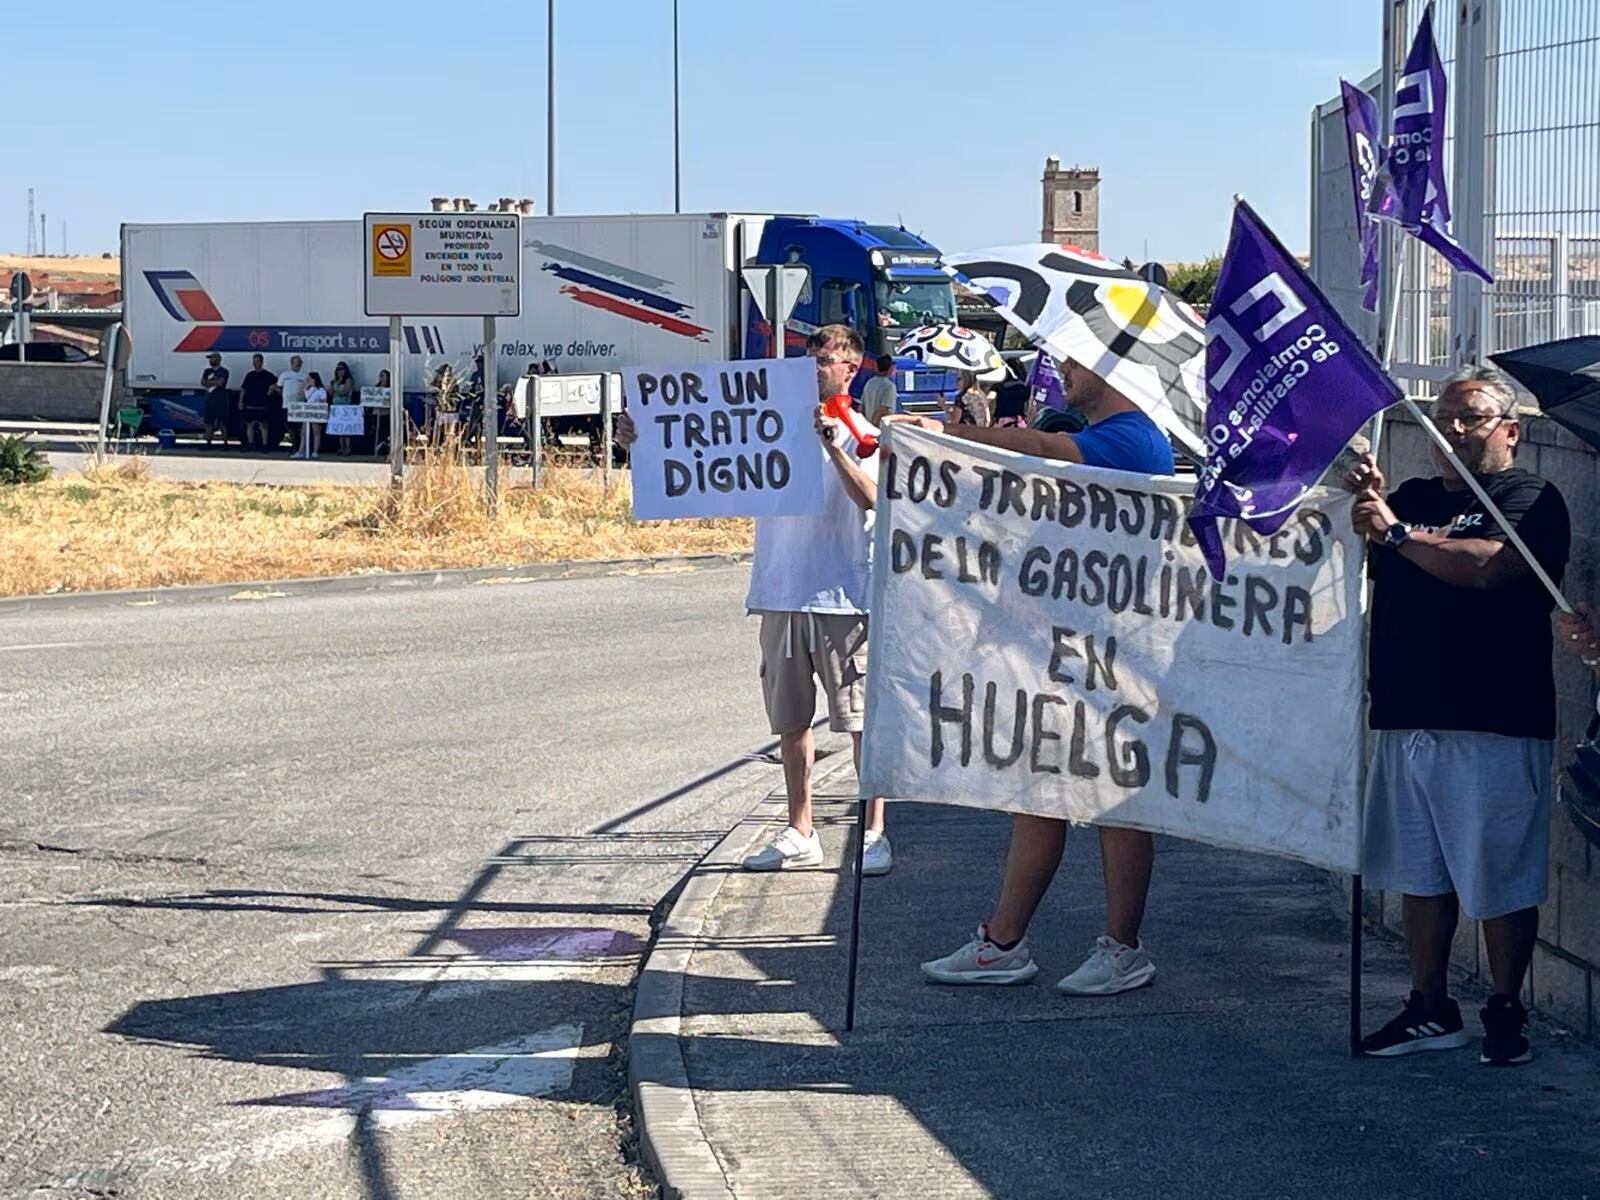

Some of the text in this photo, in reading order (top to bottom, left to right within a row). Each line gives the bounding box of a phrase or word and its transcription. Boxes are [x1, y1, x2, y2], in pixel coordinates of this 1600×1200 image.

[418, 217, 516, 229] SEGÚN ORDENANZA
[439, 231, 494, 240] MUNICIPAL
[444, 241, 490, 250] PROHIBIDO
[425, 251, 503, 260] ENCENDER FUEGO
[440, 263, 494, 271] EN TODO EL
[420, 273, 516, 283] POLÍGONO INDUSTRIAL
[278, 331, 344, 352] Transport
[501, 340, 538, 357] relax,
[543, 343, 563, 356] we
[567, 340, 617, 356] deliver.
[637, 367, 768, 407] POR UN
[654, 408, 784, 449] TRATO
[886, 453, 961, 509] LOS
[1049, 625, 1119, 691] EN
[928, 671, 1218, 804] HUELGA
